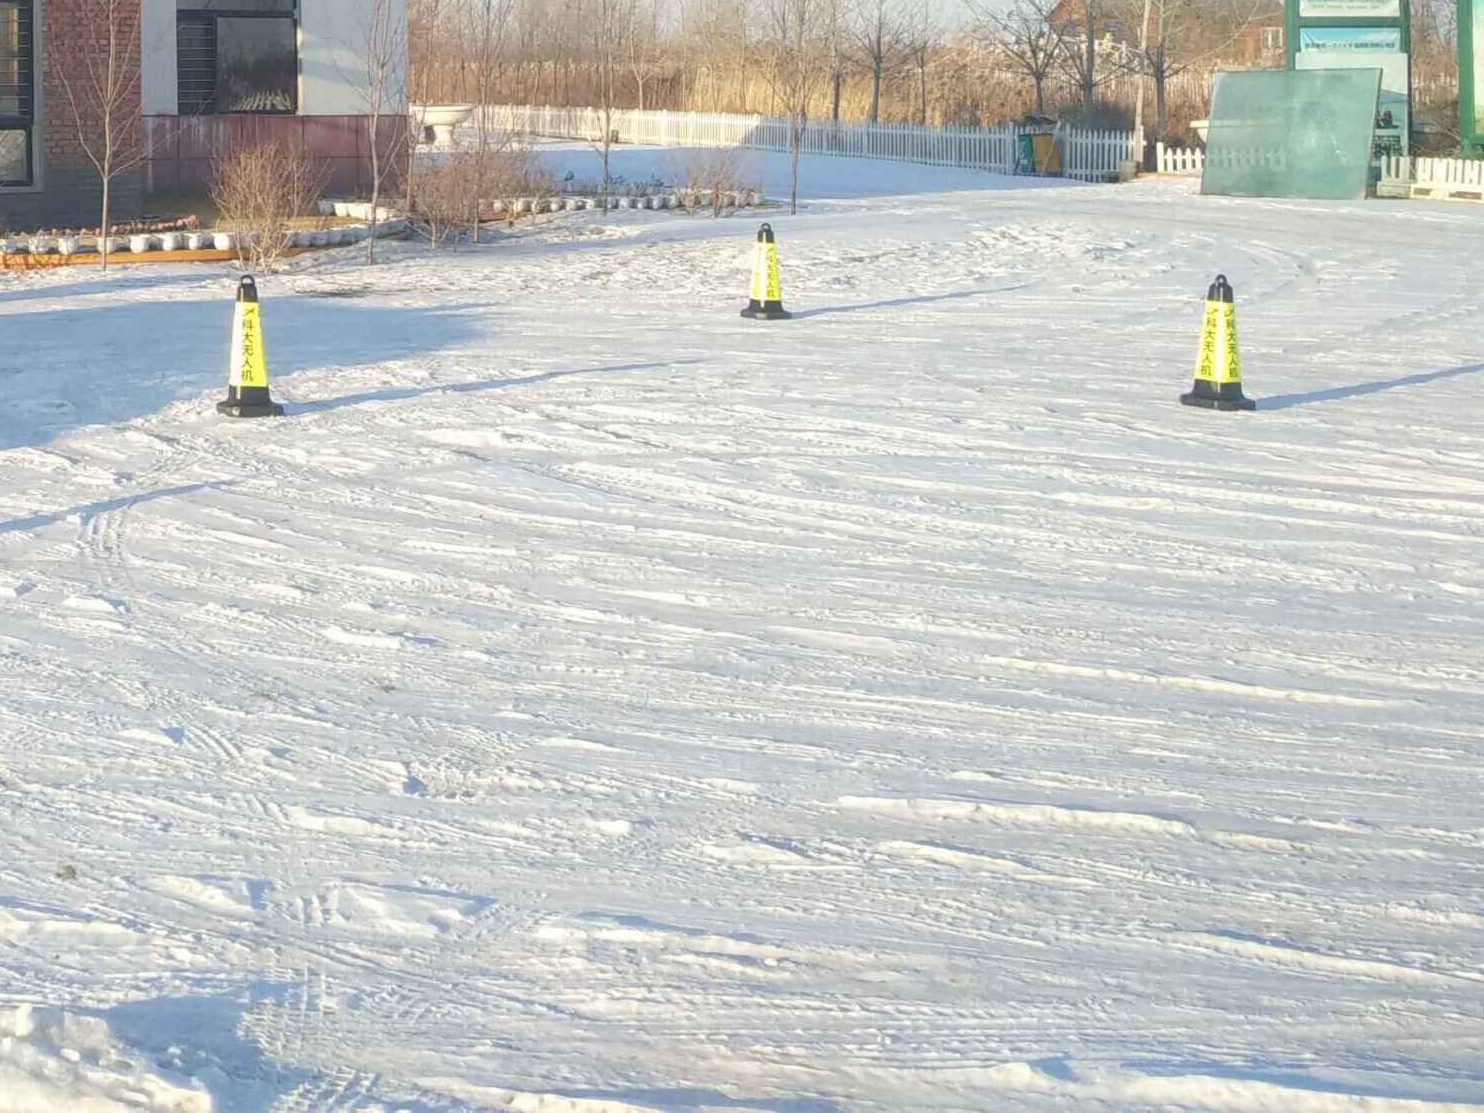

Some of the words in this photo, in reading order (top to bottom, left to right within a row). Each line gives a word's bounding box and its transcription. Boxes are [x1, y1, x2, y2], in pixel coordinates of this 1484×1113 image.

[242, 319, 254, 382] 科大无人机
[1200, 318, 1216, 376] 科大无人机
[1226, 319, 1238, 378] 科大无人机
